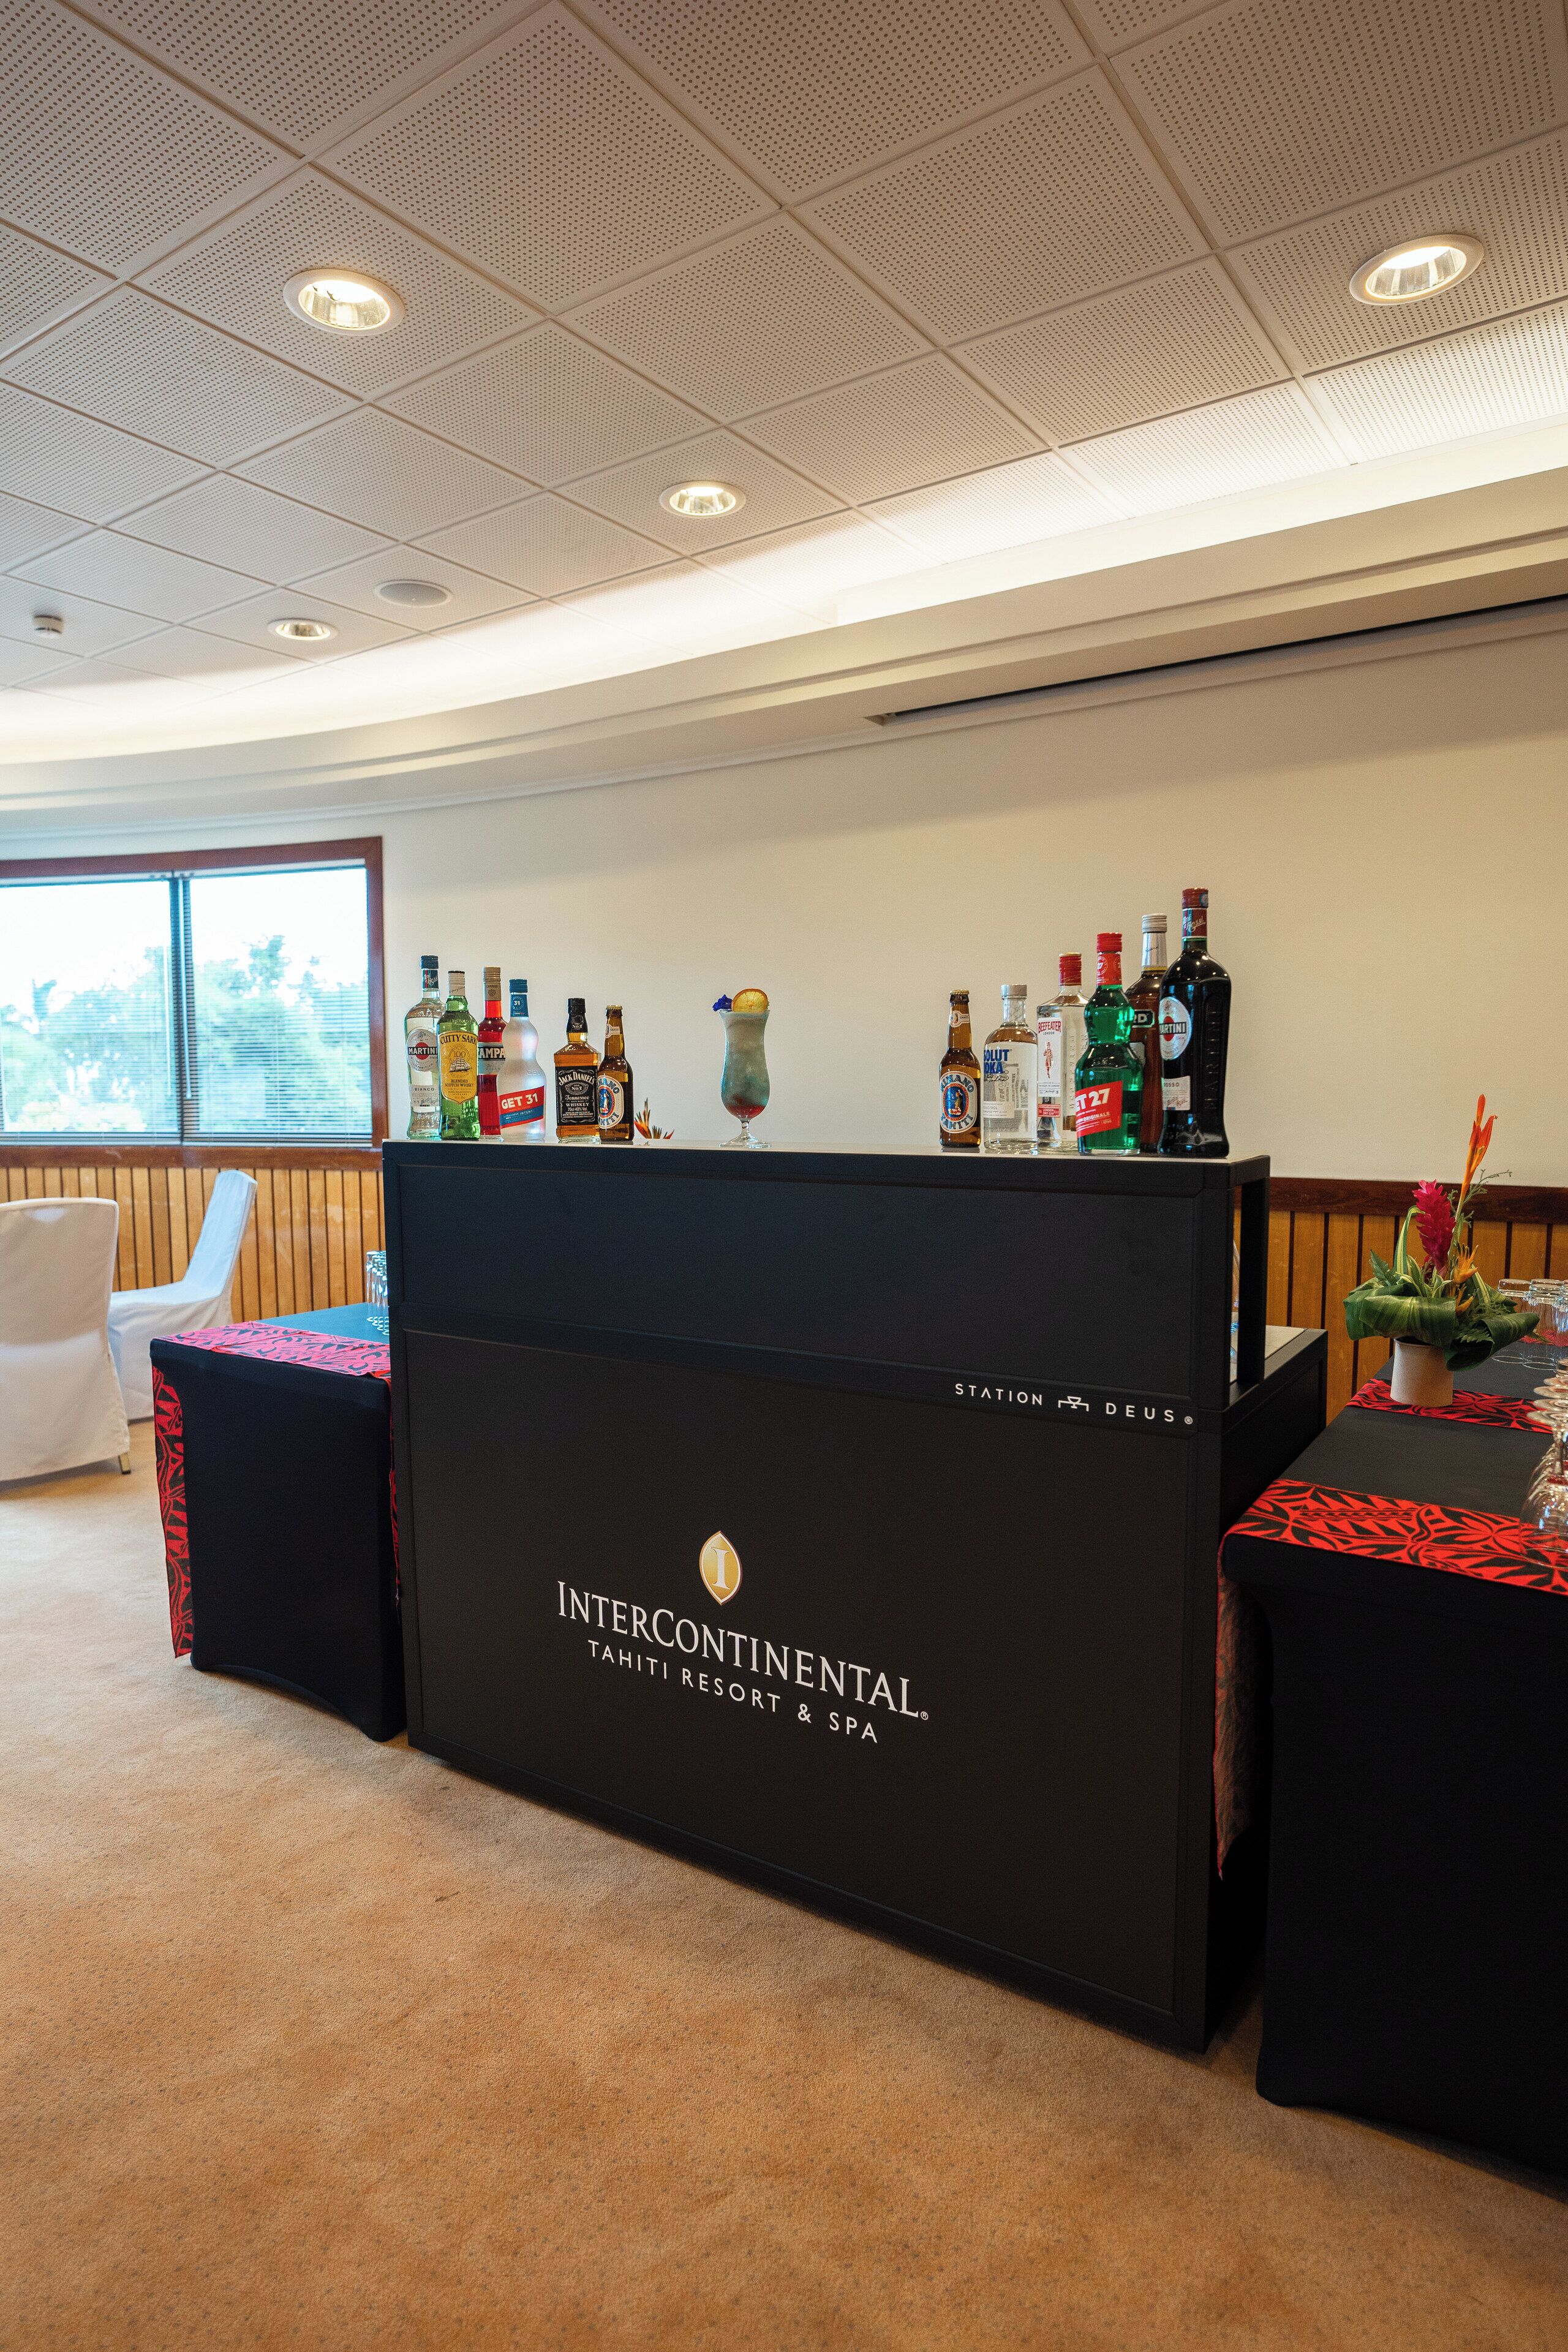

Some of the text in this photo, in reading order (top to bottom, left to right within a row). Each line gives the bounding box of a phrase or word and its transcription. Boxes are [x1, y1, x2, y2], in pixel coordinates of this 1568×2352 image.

[1038, 1020, 1061, 1033] BEEFEATER
[440, 1034, 477, 1046] CUTTY SARK
[478, 1047, 505, 1058] AMPA
[558, 1071, 596, 1086] JACK DANIEL'S
[598, 1077, 619, 1094] NANO
[940, 1074, 974, 1093] HINANO
[501, 1096, 522, 1109] GET
[525, 1093, 538, 1104] 31
[1075, 1087, 1110, 1112] ET 27
[940, 1113, 974, 1129] TAHITI
[955, 1383, 1174, 1422] STATION DEUS
[588, 1640, 878, 1744] TAHITI RESORT & SPA
